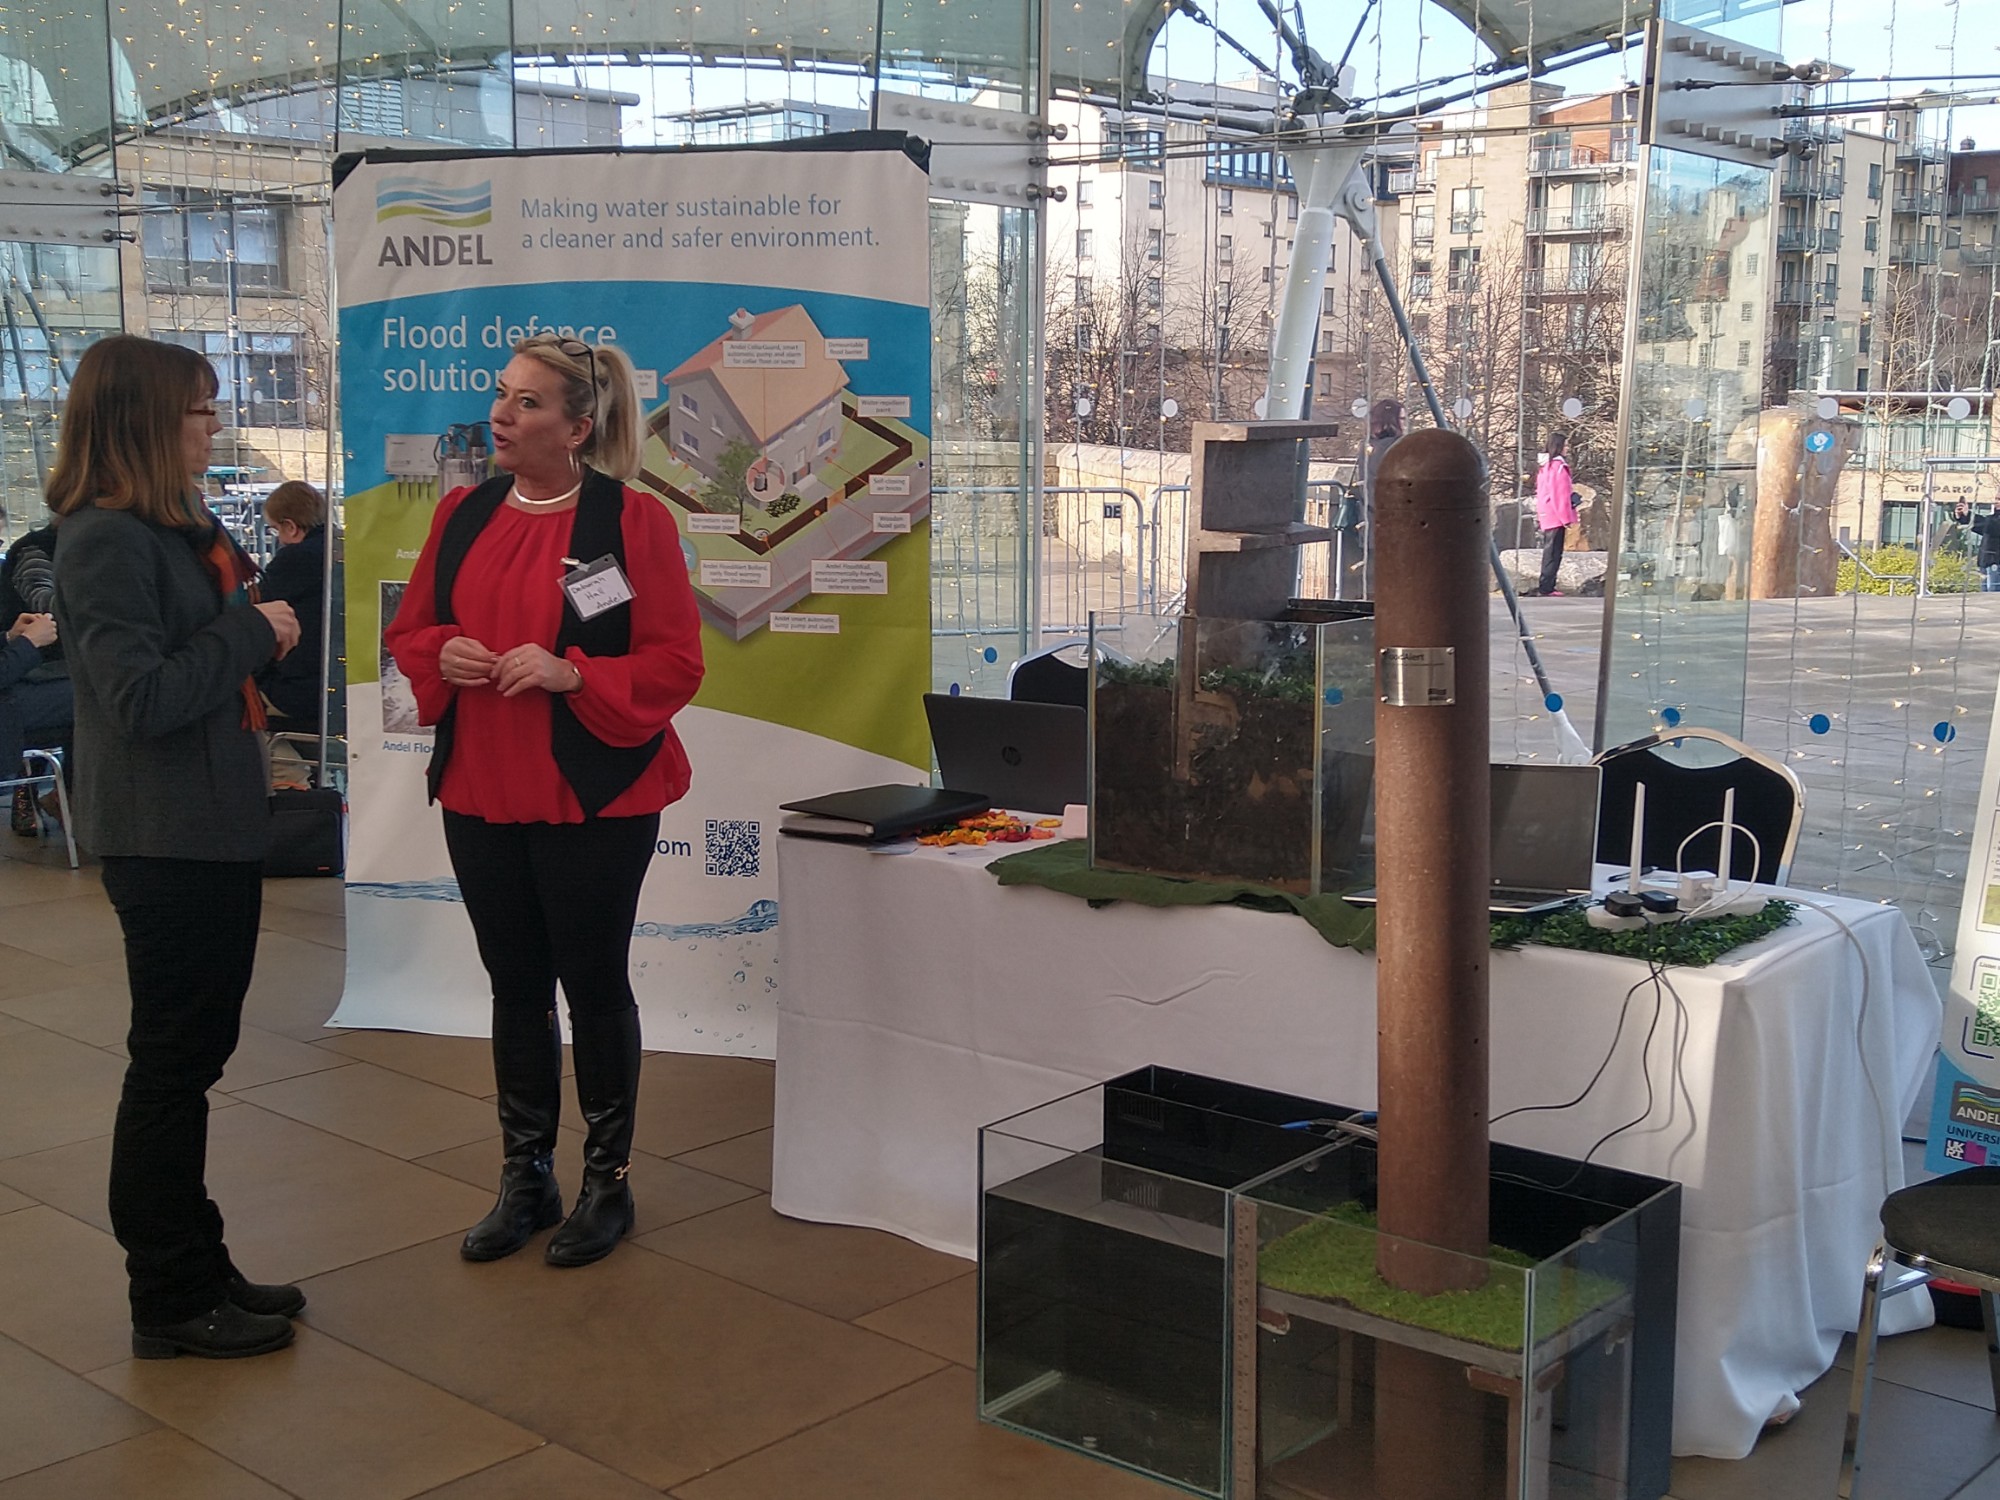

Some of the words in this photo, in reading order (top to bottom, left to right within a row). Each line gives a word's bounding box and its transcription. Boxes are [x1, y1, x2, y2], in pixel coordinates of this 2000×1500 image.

[521, 197, 598, 223] Making
[605, 199, 669, 217] water
[676, 194, 800, 217] sustainable
[808, 193, 842, 215] for
[522, 232, 533, 248] a
[540, 227, 616, 248] cleaner
[622, 227, 663, 248] and
[672, 226, 723, 248] safer
[731, 226, 880, 248] environment.
[378, 234, 493, 267] ANDEL
[383, 315, 467, 349] Flood
[383, 359, 502, 392] solutio
[383, 740, 411, 752] Andel
[414, 742, 433, 754] Flo
[656, 839, 692, 857] om
[1956, 1106, 2000, 1125] ANDEL
